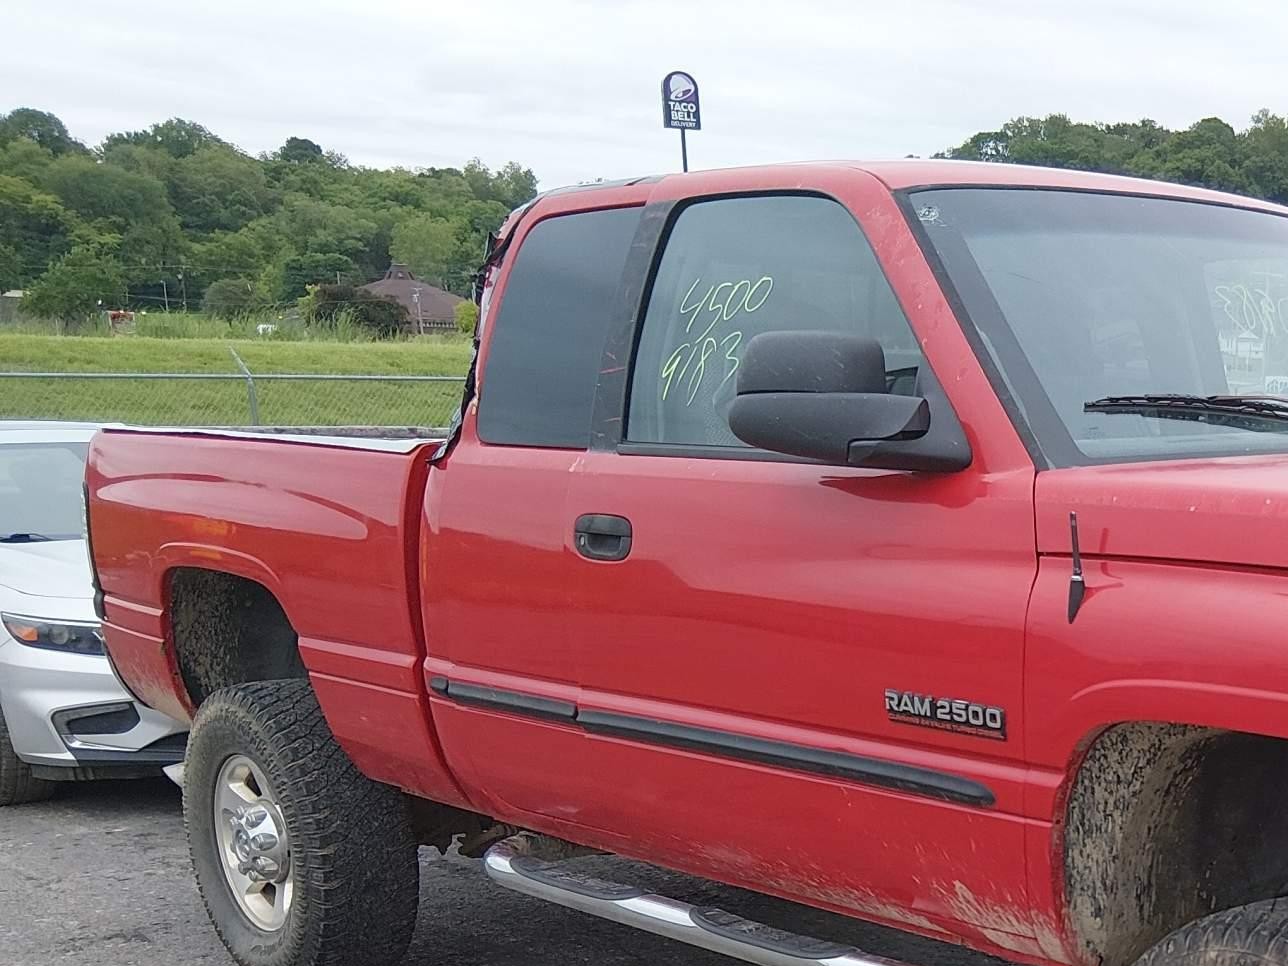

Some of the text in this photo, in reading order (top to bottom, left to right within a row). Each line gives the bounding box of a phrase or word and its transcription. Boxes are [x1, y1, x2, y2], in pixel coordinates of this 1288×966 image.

[668, 101, 697, 113] TACO
[671, 110, 697, 122] BELL
[680, 276, 774, 344] 4500
[661, 331, 743, 407] 9183
[884, 691, 932, 717] RAM
[936, 700, 1001, 729] 2500
